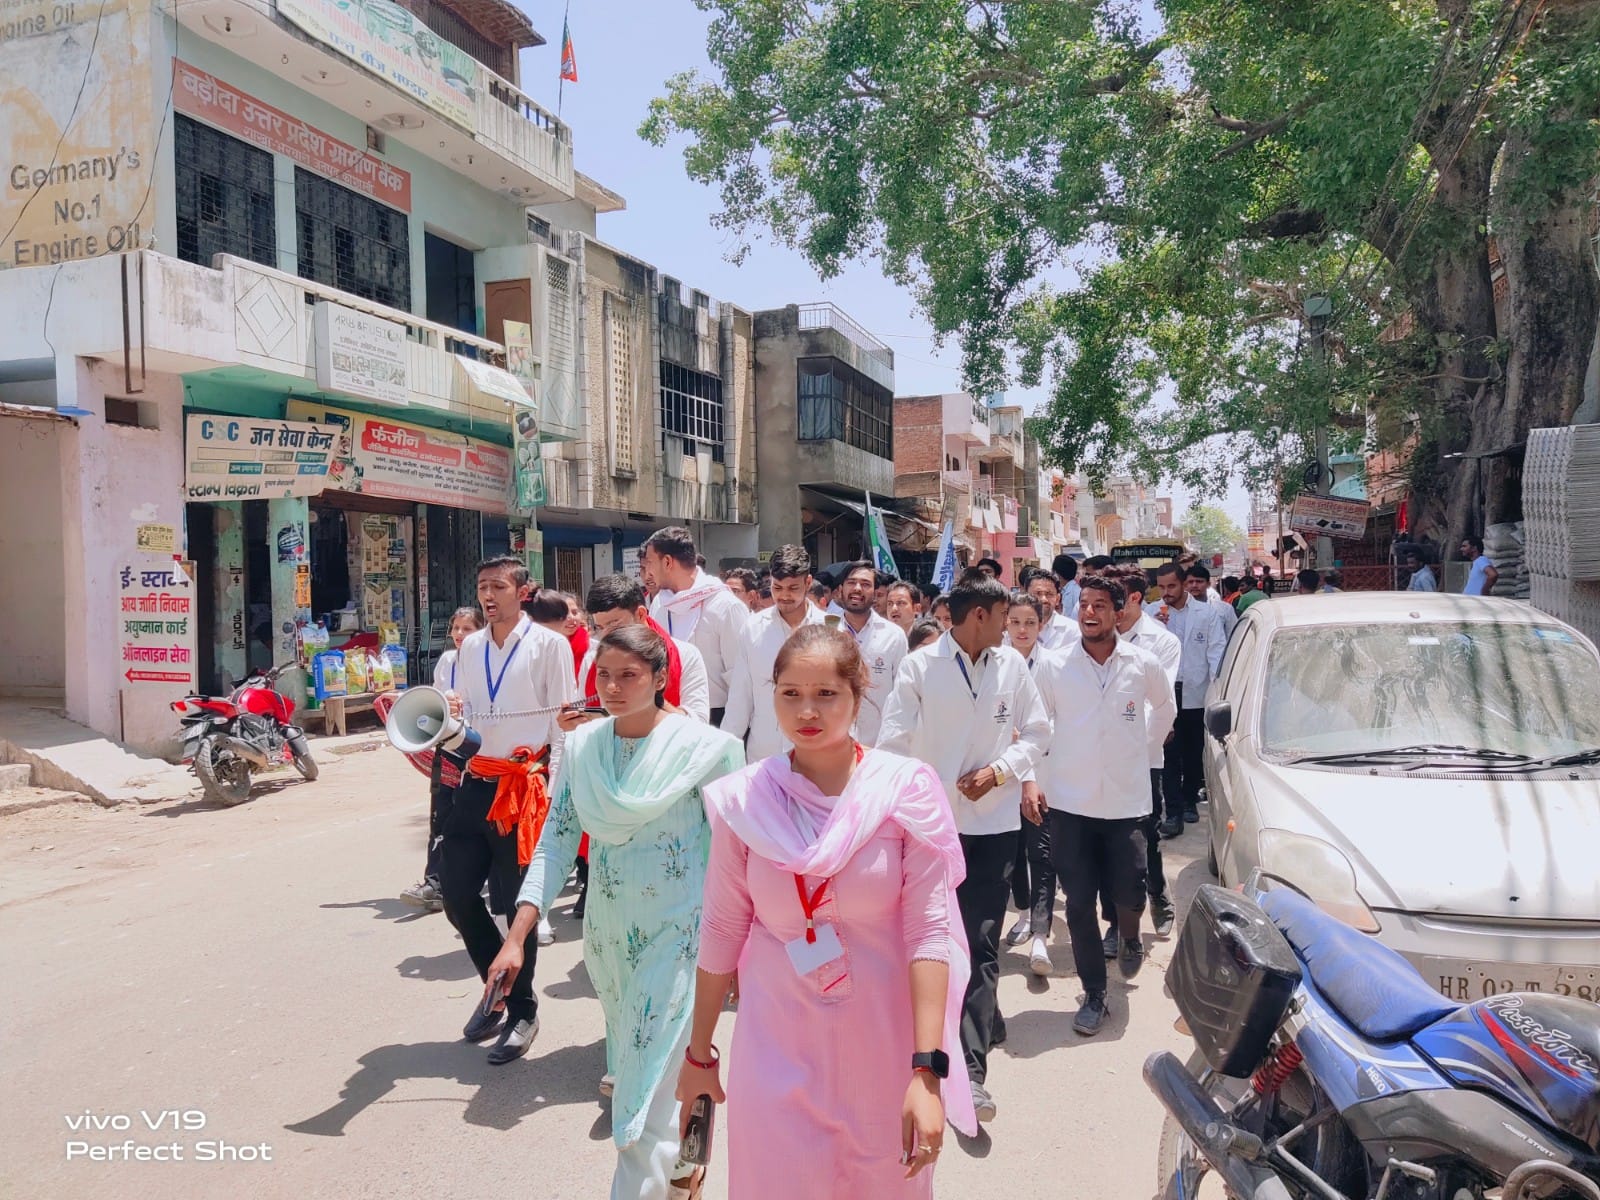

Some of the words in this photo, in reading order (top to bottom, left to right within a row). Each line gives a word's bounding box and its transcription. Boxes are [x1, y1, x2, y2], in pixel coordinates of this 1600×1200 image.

[52, 3, 75, 27] Oil
[241, 98, 287, 137] उत्तर
[285, 119, 328, 157] प्रदेश
[327, 140, 379, 181] ग्रामीण
[378, 161, 405, 193] बैंक
[10, 146, 141, 190] Germany's
[54, 194, 101, 225] No.1
[14, 233, 98, 265] Engine
[106, 222, 140, 252] Oil
[201, 420, 239, 441] CSC
[250, 427, 275, 446] जन
[278, 424, 306, 447] सेवा
[307, 426, 335, 450] केन्द्र
[1148, 548, 1180, 558] College
[121, 597, 137, 613] आय
[138, 593, 157, 613] जाति
[159, 593, 190, 613] निवास
[124, 620, 163, 639] अयुष्मान
[166, 617, 188, 635] कार्ड
[122, 643, 168, 664] ऑनलाइन
[169, 644, 190, 663] सेवा
[1439, 976, 1470, 1000] HR
[1485, 994, 1600, 1074] Passion
[1365, 1066, 1386, 1093] Hero
